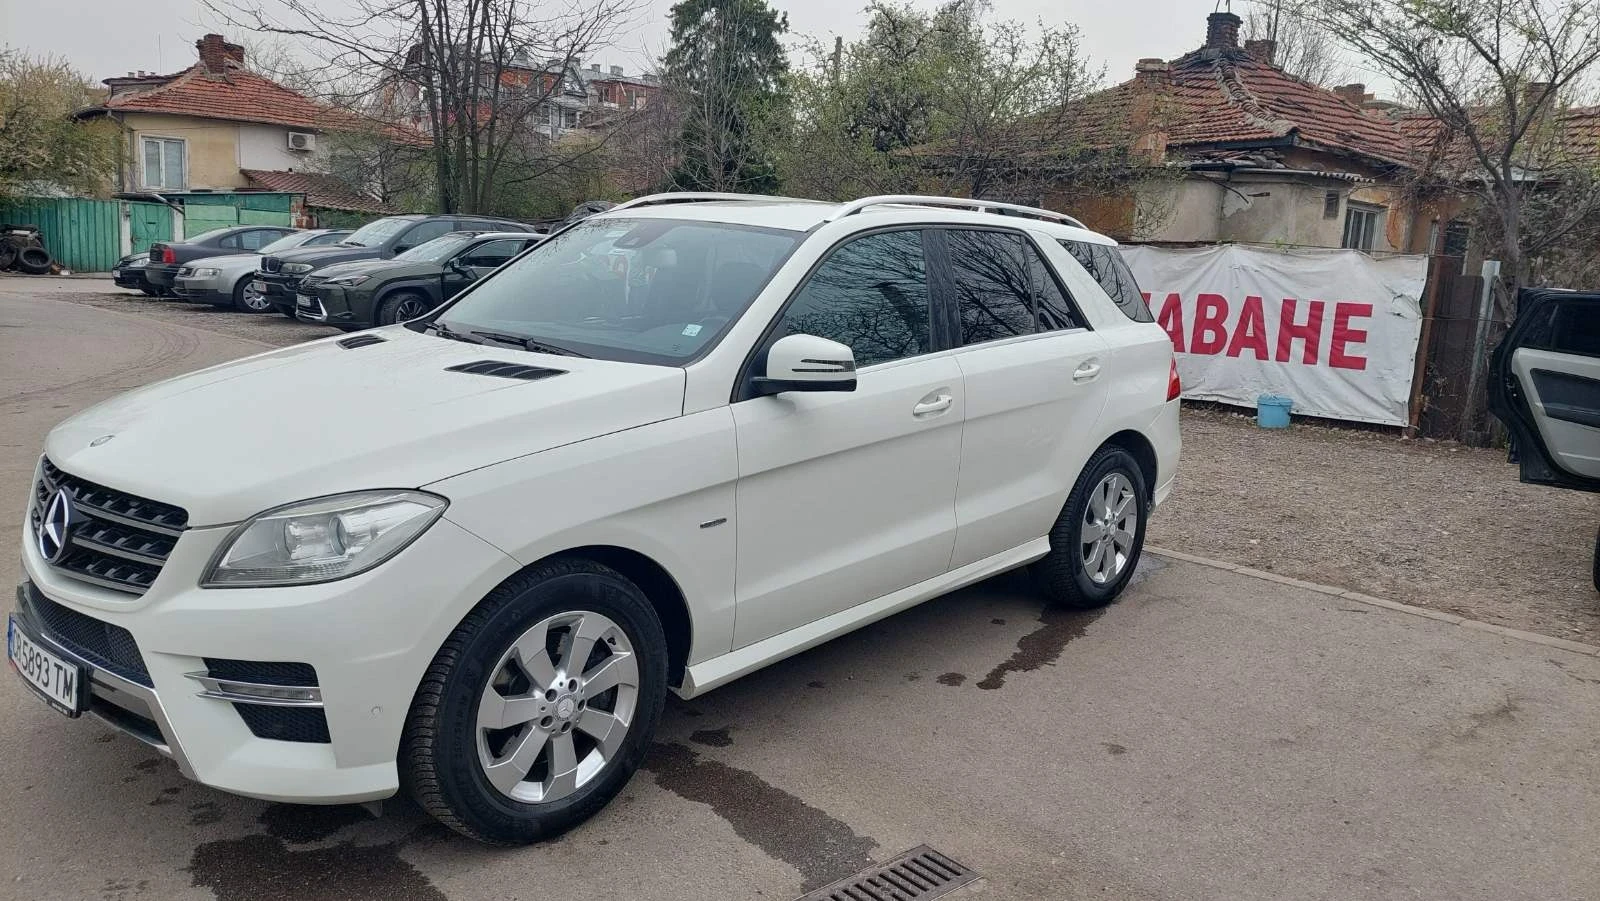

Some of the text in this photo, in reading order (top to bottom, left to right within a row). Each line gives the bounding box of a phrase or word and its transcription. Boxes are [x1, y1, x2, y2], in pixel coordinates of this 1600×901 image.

[1142, 292, 1374, 371] АВАНЕ
[21, 640, 50, 688] 5893
[53, 662, 74, 703] TM
